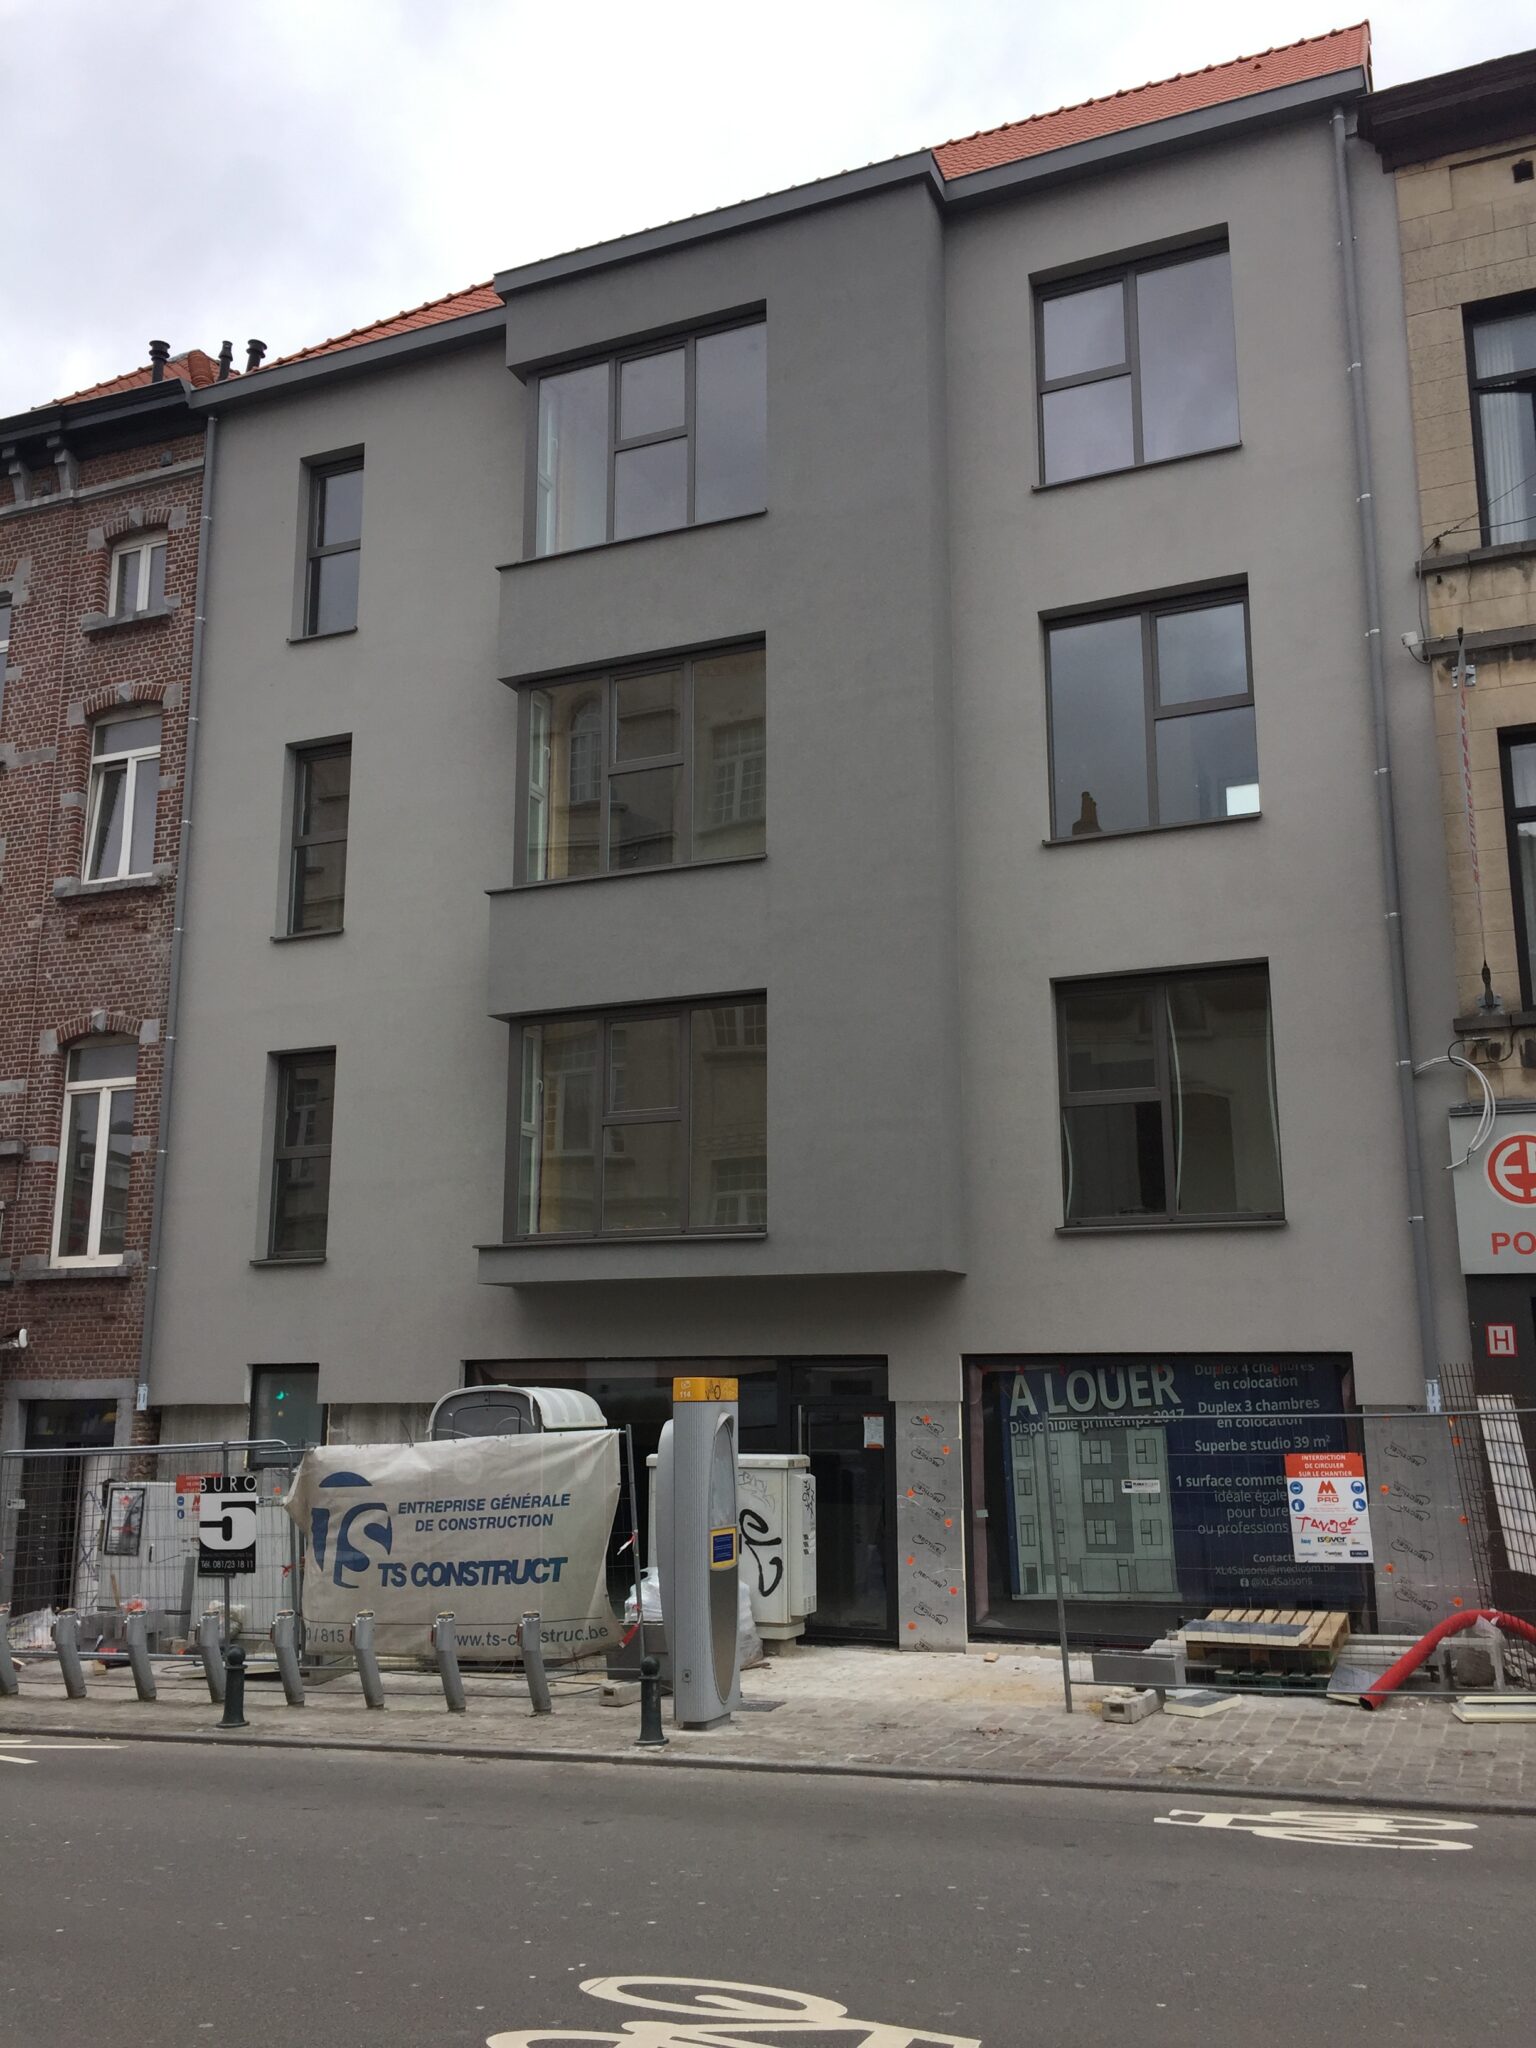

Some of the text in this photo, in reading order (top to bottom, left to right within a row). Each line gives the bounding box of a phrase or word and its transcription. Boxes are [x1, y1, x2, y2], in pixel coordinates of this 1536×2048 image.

[1493, 1330, 1510, 1348] H
[1010, 1366, 1182, 1416] A LOUER
[1214, 1376, 1299, 1390] en colocation
[1198, 1397, 1320, 1415] Duplex 3 chambres
[1010, 1420, 1079, 1437] Disponible
[1217, 1417, 1303, 1428] en colocation
[1195, 1440, 1247, 1454] Superbe
[1250, 1438, 1291, 1451] studio
[1294, 1437, 1310, 1449] 39
[200, 1475, 258, 1492] BURO
[1176, 1475, 1183, 1487] 1
[1186, 1474, 1232, 1487] surface
[398, 1493, 571, 1514] ENTREPRISE GÉNÉRALE
[1214, 1489, 1251, 1502] idéale
[415, 1514, 554, 1532] DE CONSTRUCTION
[1227, 1508, 1256, 1521] pour
[1198, 1520, 1289, 1536] ou professions
[378, 1557, 568, 1587] TS CONSTRUCT
[321, 1628, 345, 1643] 815
